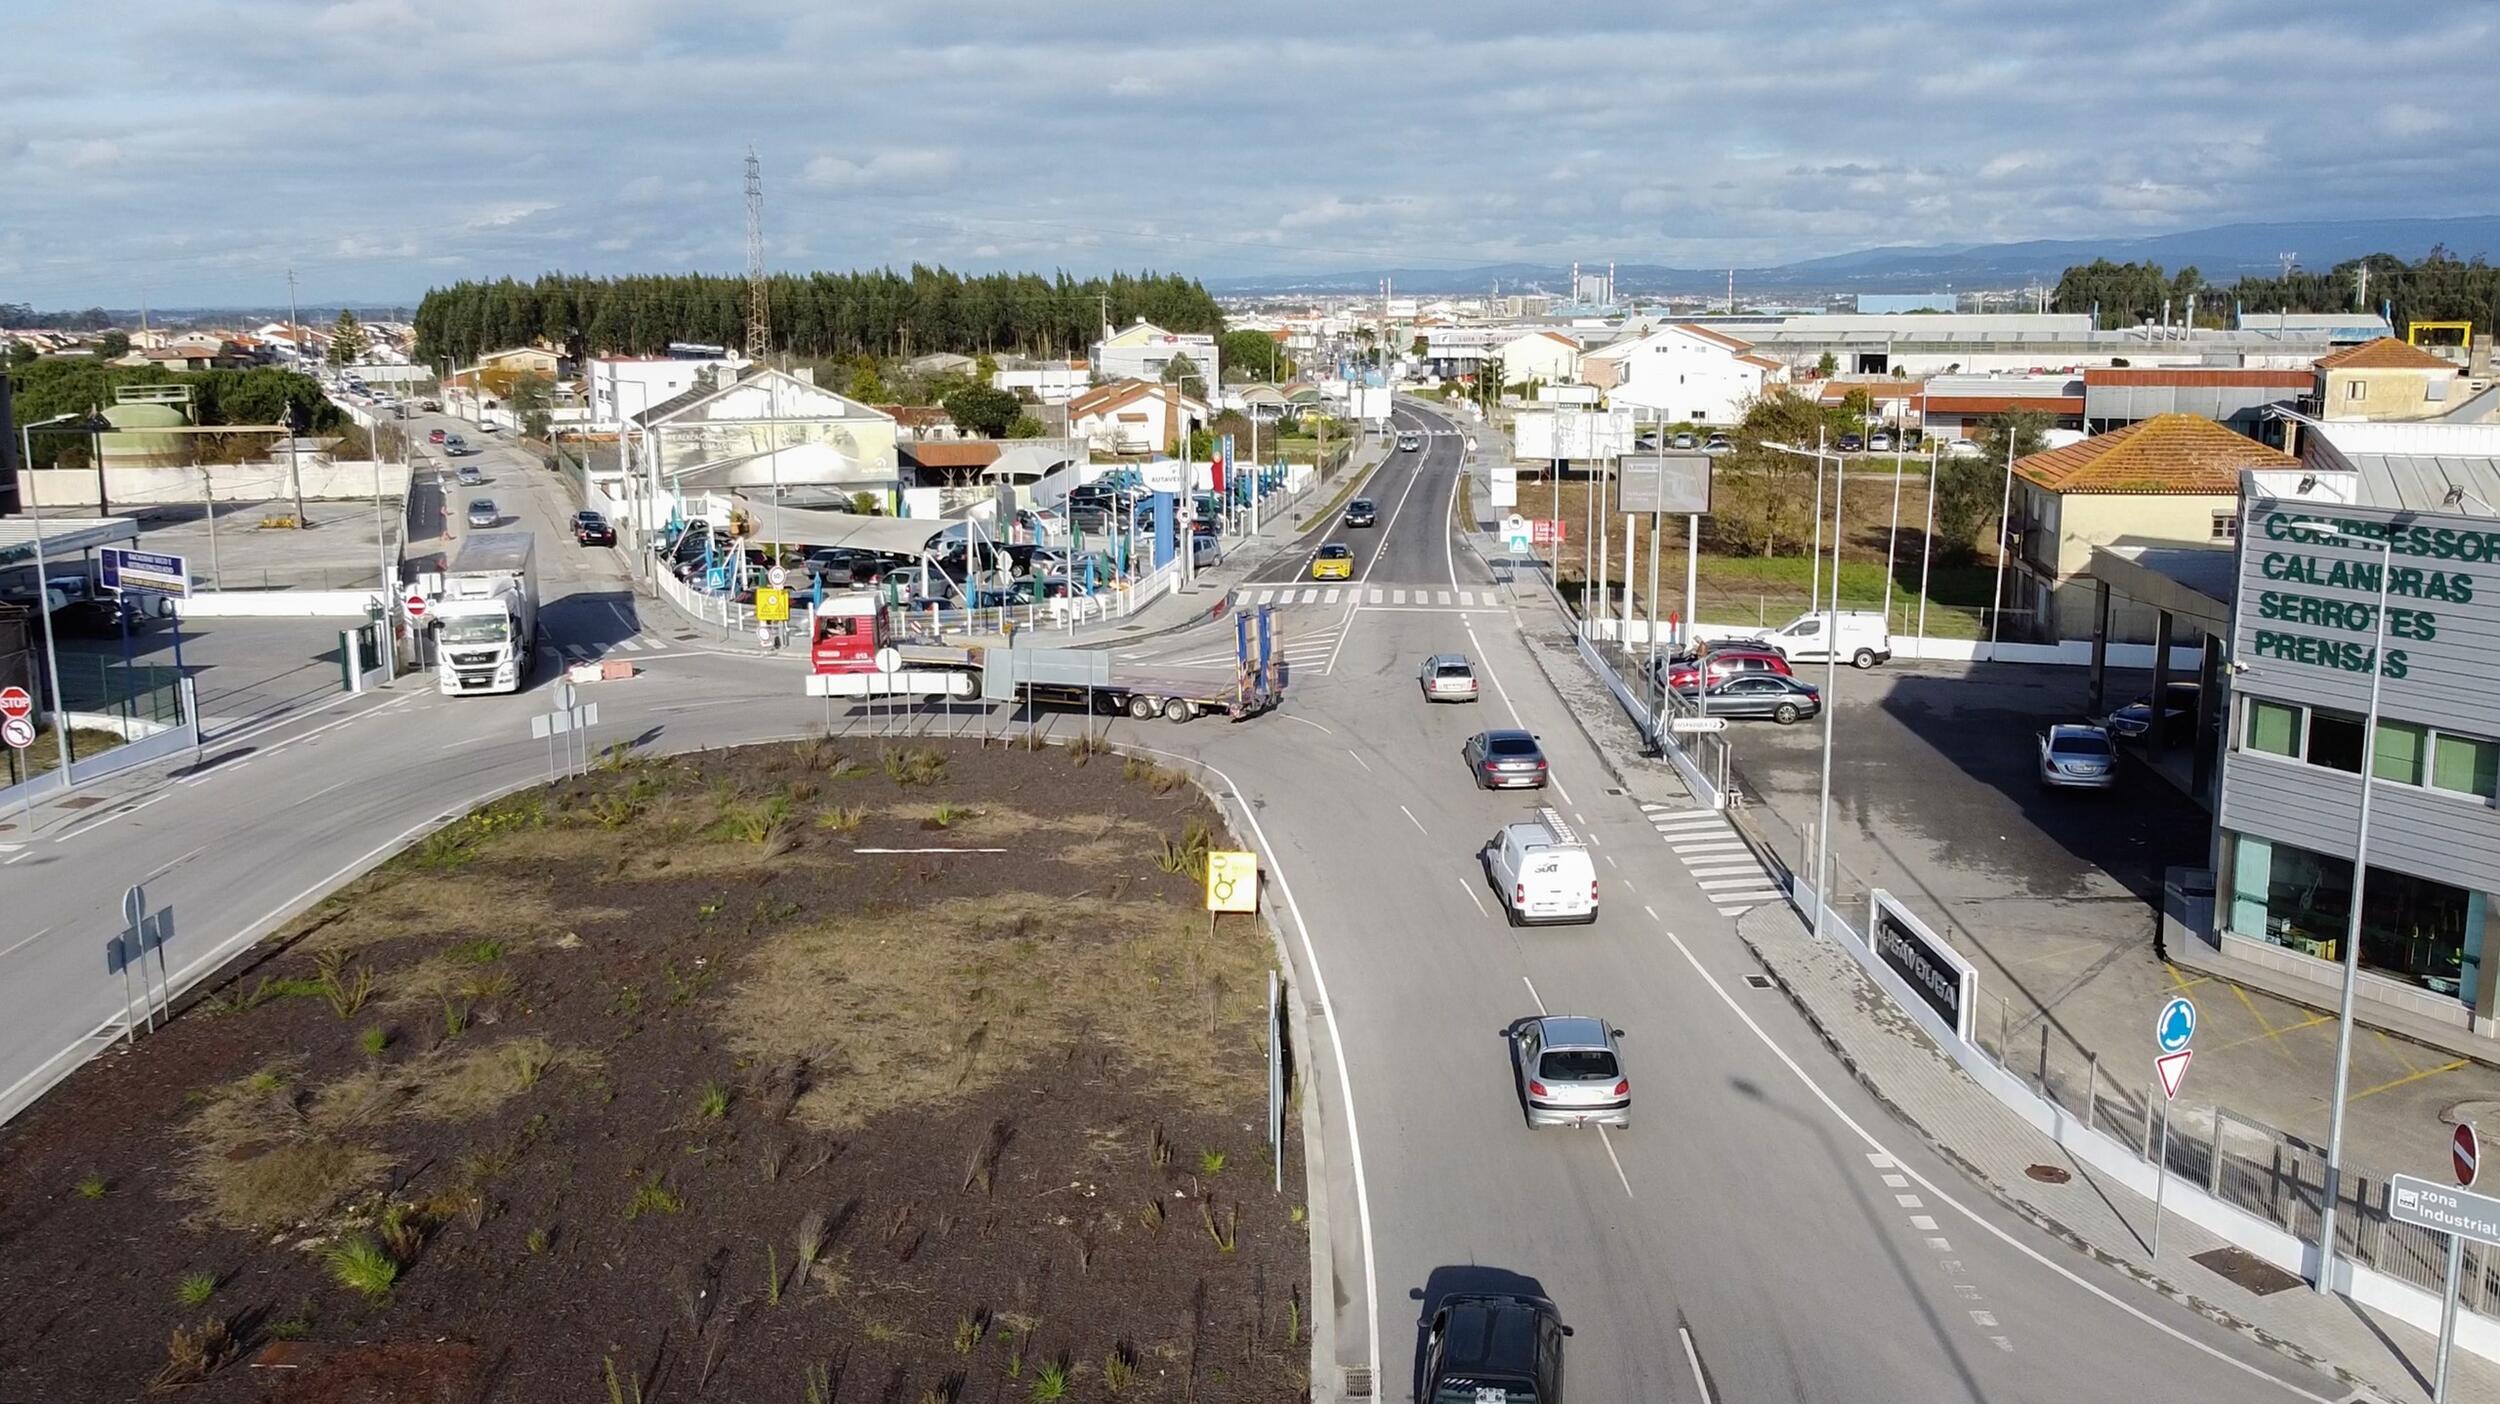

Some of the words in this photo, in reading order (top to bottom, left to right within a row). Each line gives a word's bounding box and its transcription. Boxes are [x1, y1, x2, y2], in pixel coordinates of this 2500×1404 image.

[2261, 552, 2473, 604] CALANDRAS
[2254, 630, 2408, 679] PRENSAS
[1, 697, 29, 709] STOP
[2420, 1190, 2457, 1208] zona
